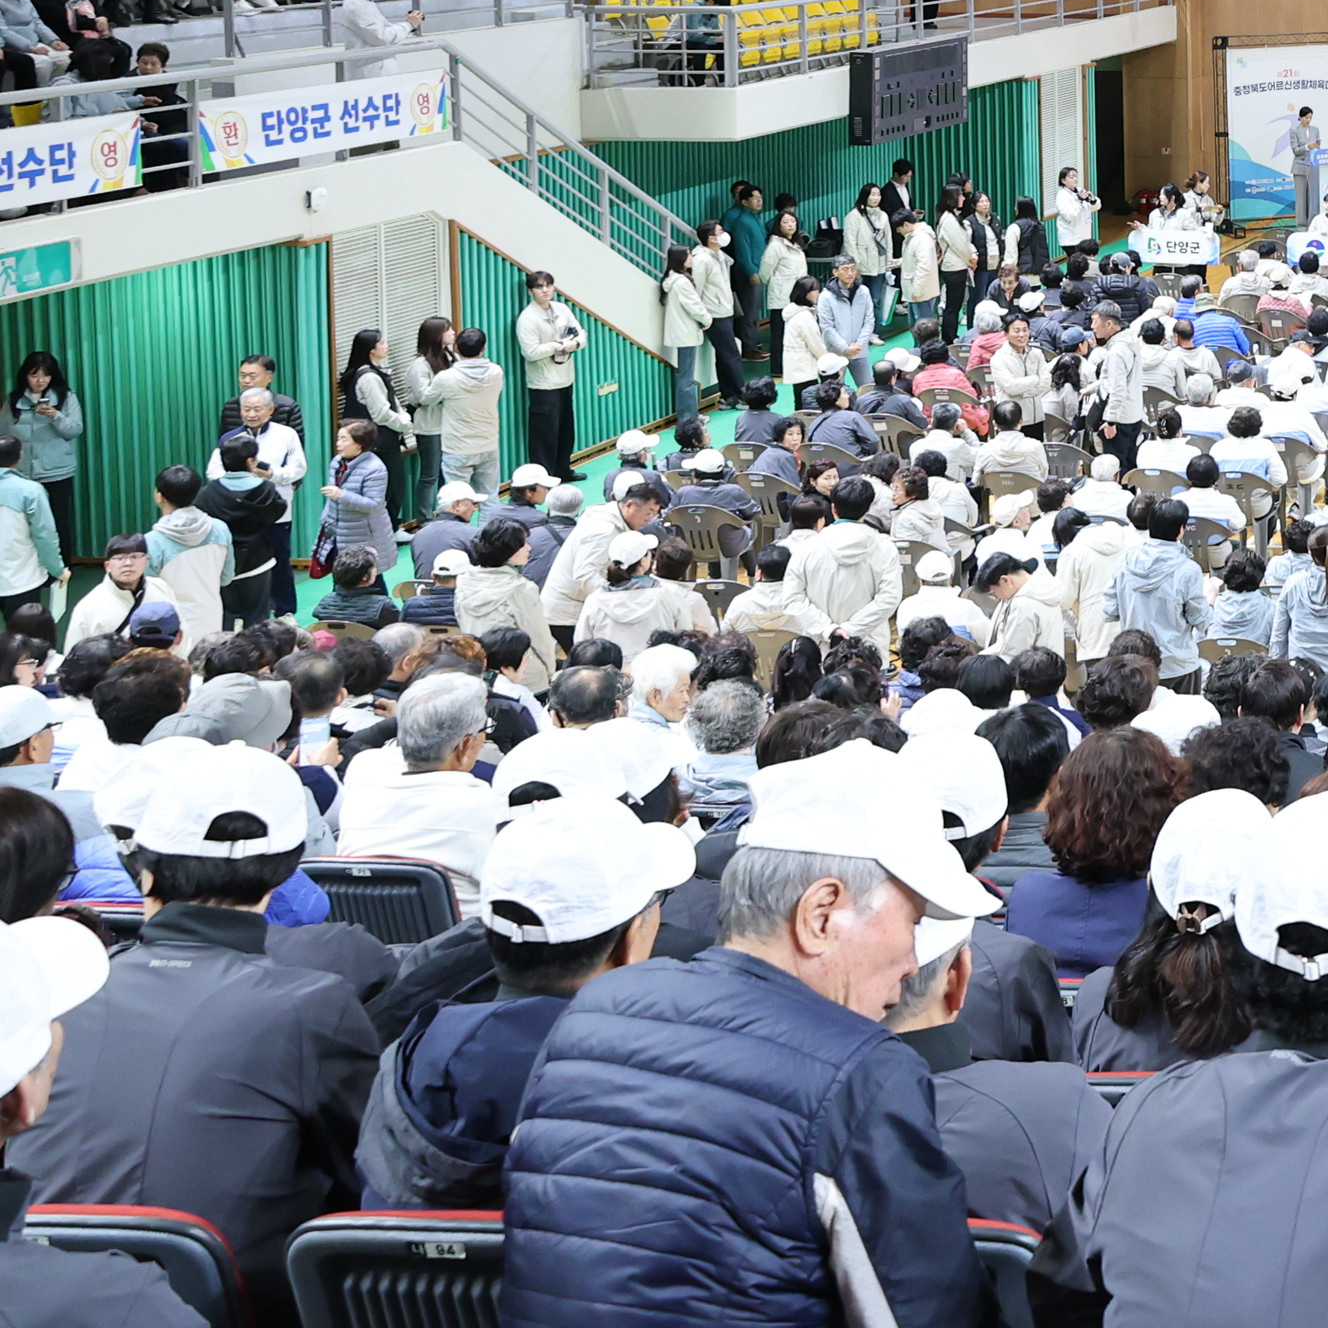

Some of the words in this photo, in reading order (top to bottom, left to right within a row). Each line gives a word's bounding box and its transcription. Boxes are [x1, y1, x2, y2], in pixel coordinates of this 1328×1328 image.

[416, 91, 432, 116] 영
[221, 119, 240, 146] 환
[260, 102, 332, 147] 단양군
[339, 92, 402, 134] 선수단
[100, 140, 119, 169] 영
[1166, 240, 1201, 254] 단양군
